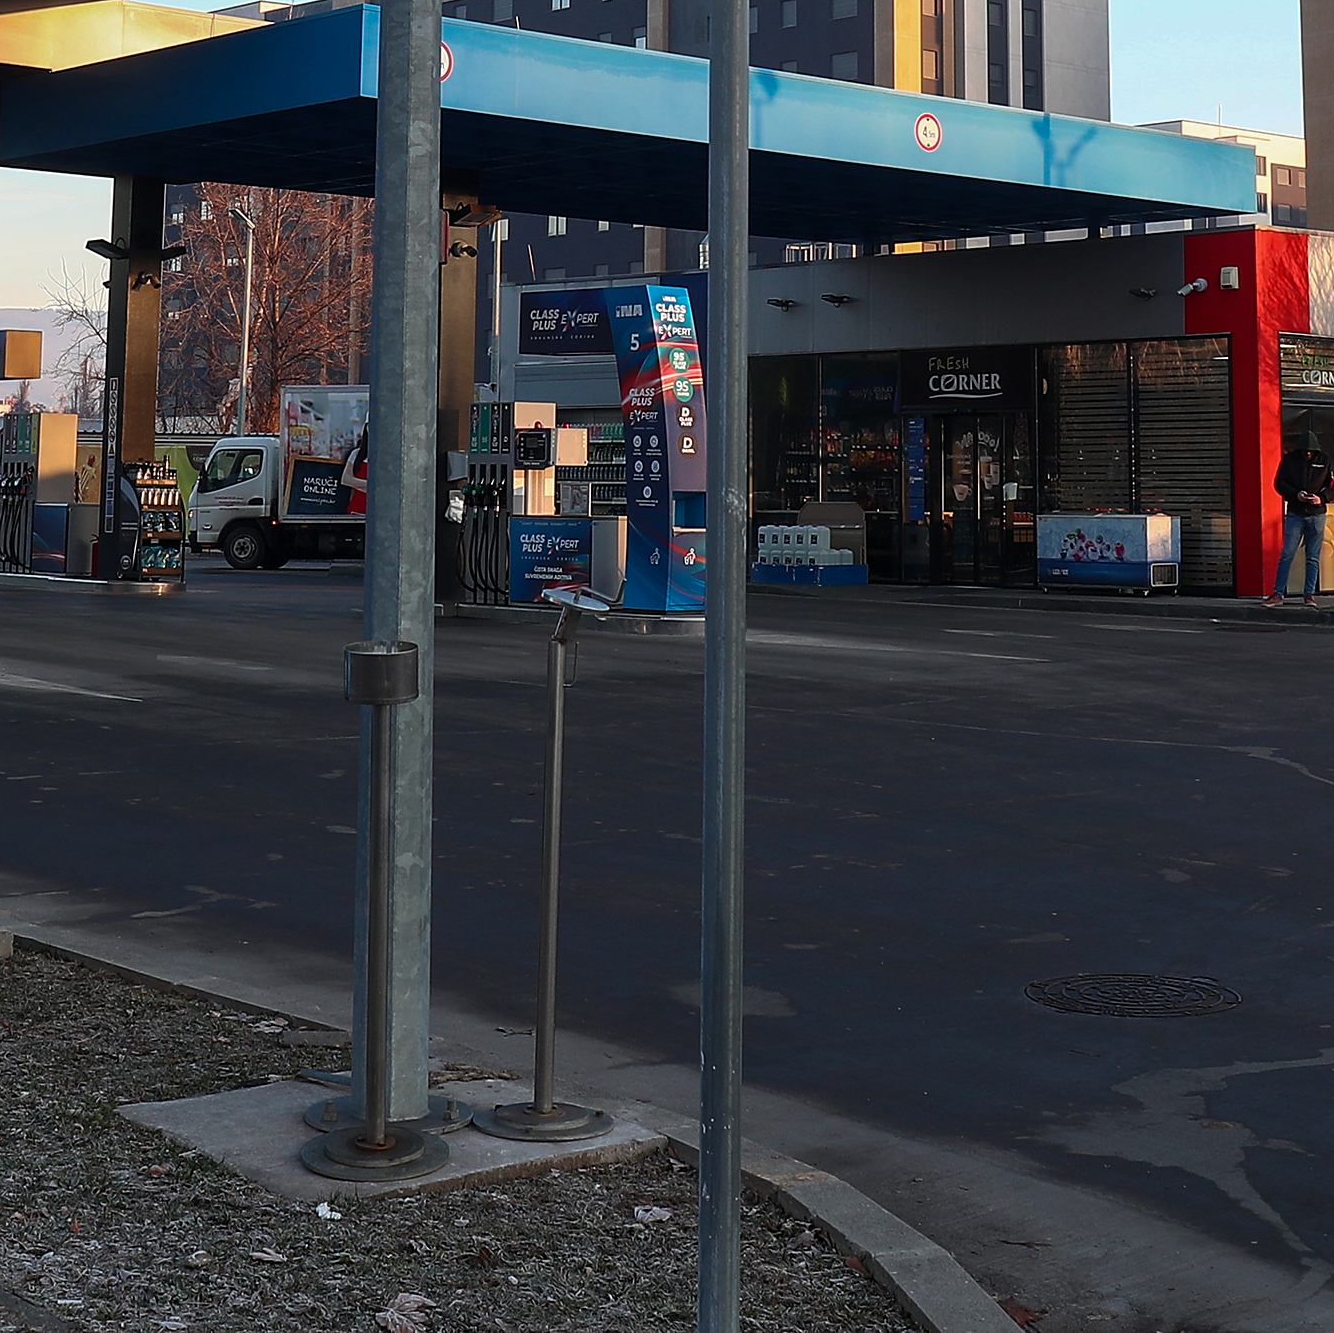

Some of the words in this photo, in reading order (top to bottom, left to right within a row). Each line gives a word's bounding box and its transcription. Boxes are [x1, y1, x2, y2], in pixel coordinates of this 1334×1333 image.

[655, 303, 686, 314] CLASS
[530, 309, 559, 320] CLASS
[660, 312, 685, 323] PLUS
[532, 320, 556, 331] PLUS
[630, 333, 640, 351] 5
[673, 352, 685, 361] 95
[928, 356, 970, 371] FRESH
[676, 381, 689, 392] 95
[929, 373, 1002, 392] CORNER
[629, 388, 655, 397] CLASS
[631, 397, 652, 406] PLUS
[682, 407, 690, 417] D
[683, 437, 692, 448] D
[304, 475, 338, 487] NARUČI
[304, 485, 337, 495] ONLINE
[520, 534, 545, 543] CLASS
[522, 544, 543, 552] PLUS
